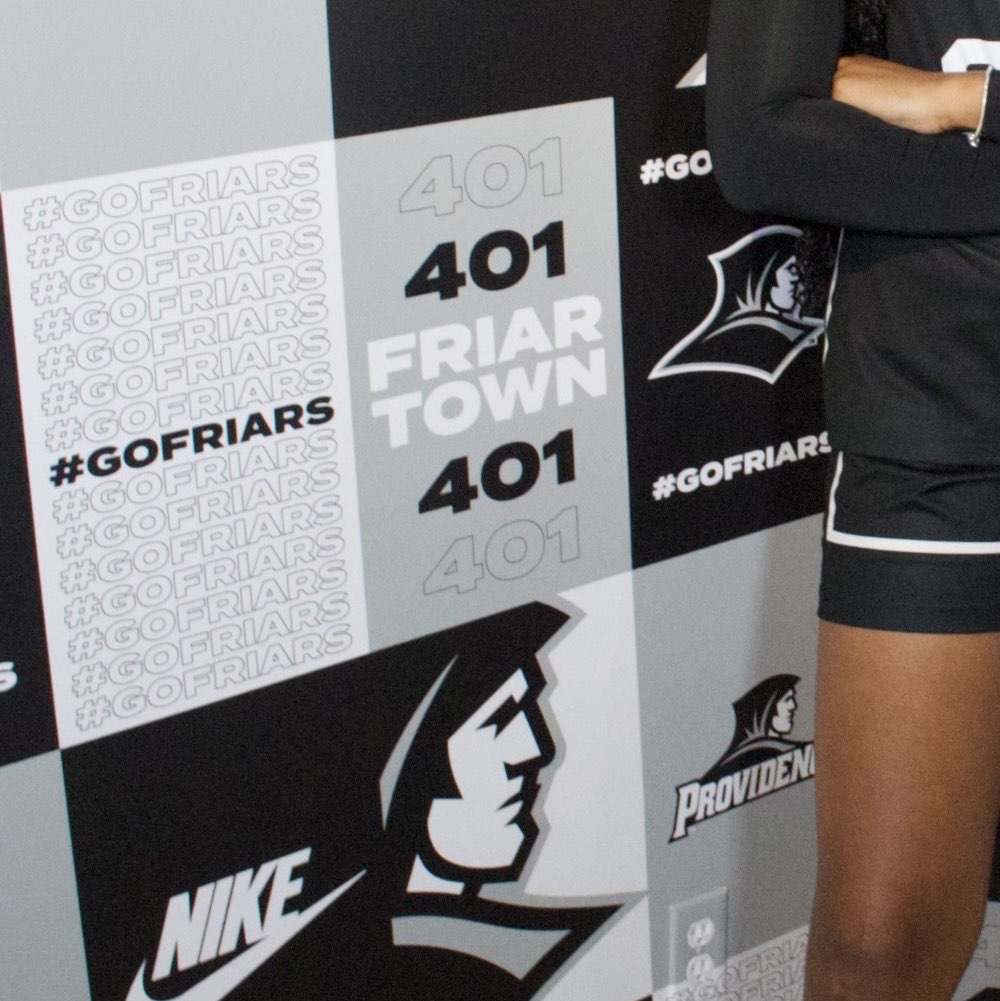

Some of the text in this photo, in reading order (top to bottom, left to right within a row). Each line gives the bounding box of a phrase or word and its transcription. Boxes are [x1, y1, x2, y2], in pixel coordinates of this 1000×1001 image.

[23, 156, 319, 230] #GOFRIARS
[399, 136, 563, 217] 401
[640, 149, 713, 185] #GO
[27, 191, 322, 268] #GOFRIARS
[31, 225, 324, 305] #GOFRIARS
[404, 220, 566, 301] 401
[34, 260, 326, 343] #GOFRIARS
[38, 294, 328, 379] #GOFRIARS
[366, 294, 604, 392] FRIAR
[41, 328, 331, 416] #GOFRIARS
[45, 362, 333, 452] #GOFRIARS
[370, 347, 607, 448] TOWN
[50, 396, 335, 486] #GOFRIARS
[53, 429, 337, 523] #GOFRIARS
[418, 428, 576, 515] 401
[652, 430, 833, 501] #GOFRIARS
[57, 462, 340, 559] #GOFRIARS
[60, 496, 343, 595] #GOFRIARS
[422, 505, 581, 596] 401
[64, 528, 345, 628] #GOFRIARS
[68, 560, 348, 662] #GOFRIARS
[72, 592, 350, 696] #GOFRIARS
[76, 625, 352, 731] #GOFRIARS
[671, 742, 816, 841] PROVIDEN
[151, 846, 312, 983] NIKE
